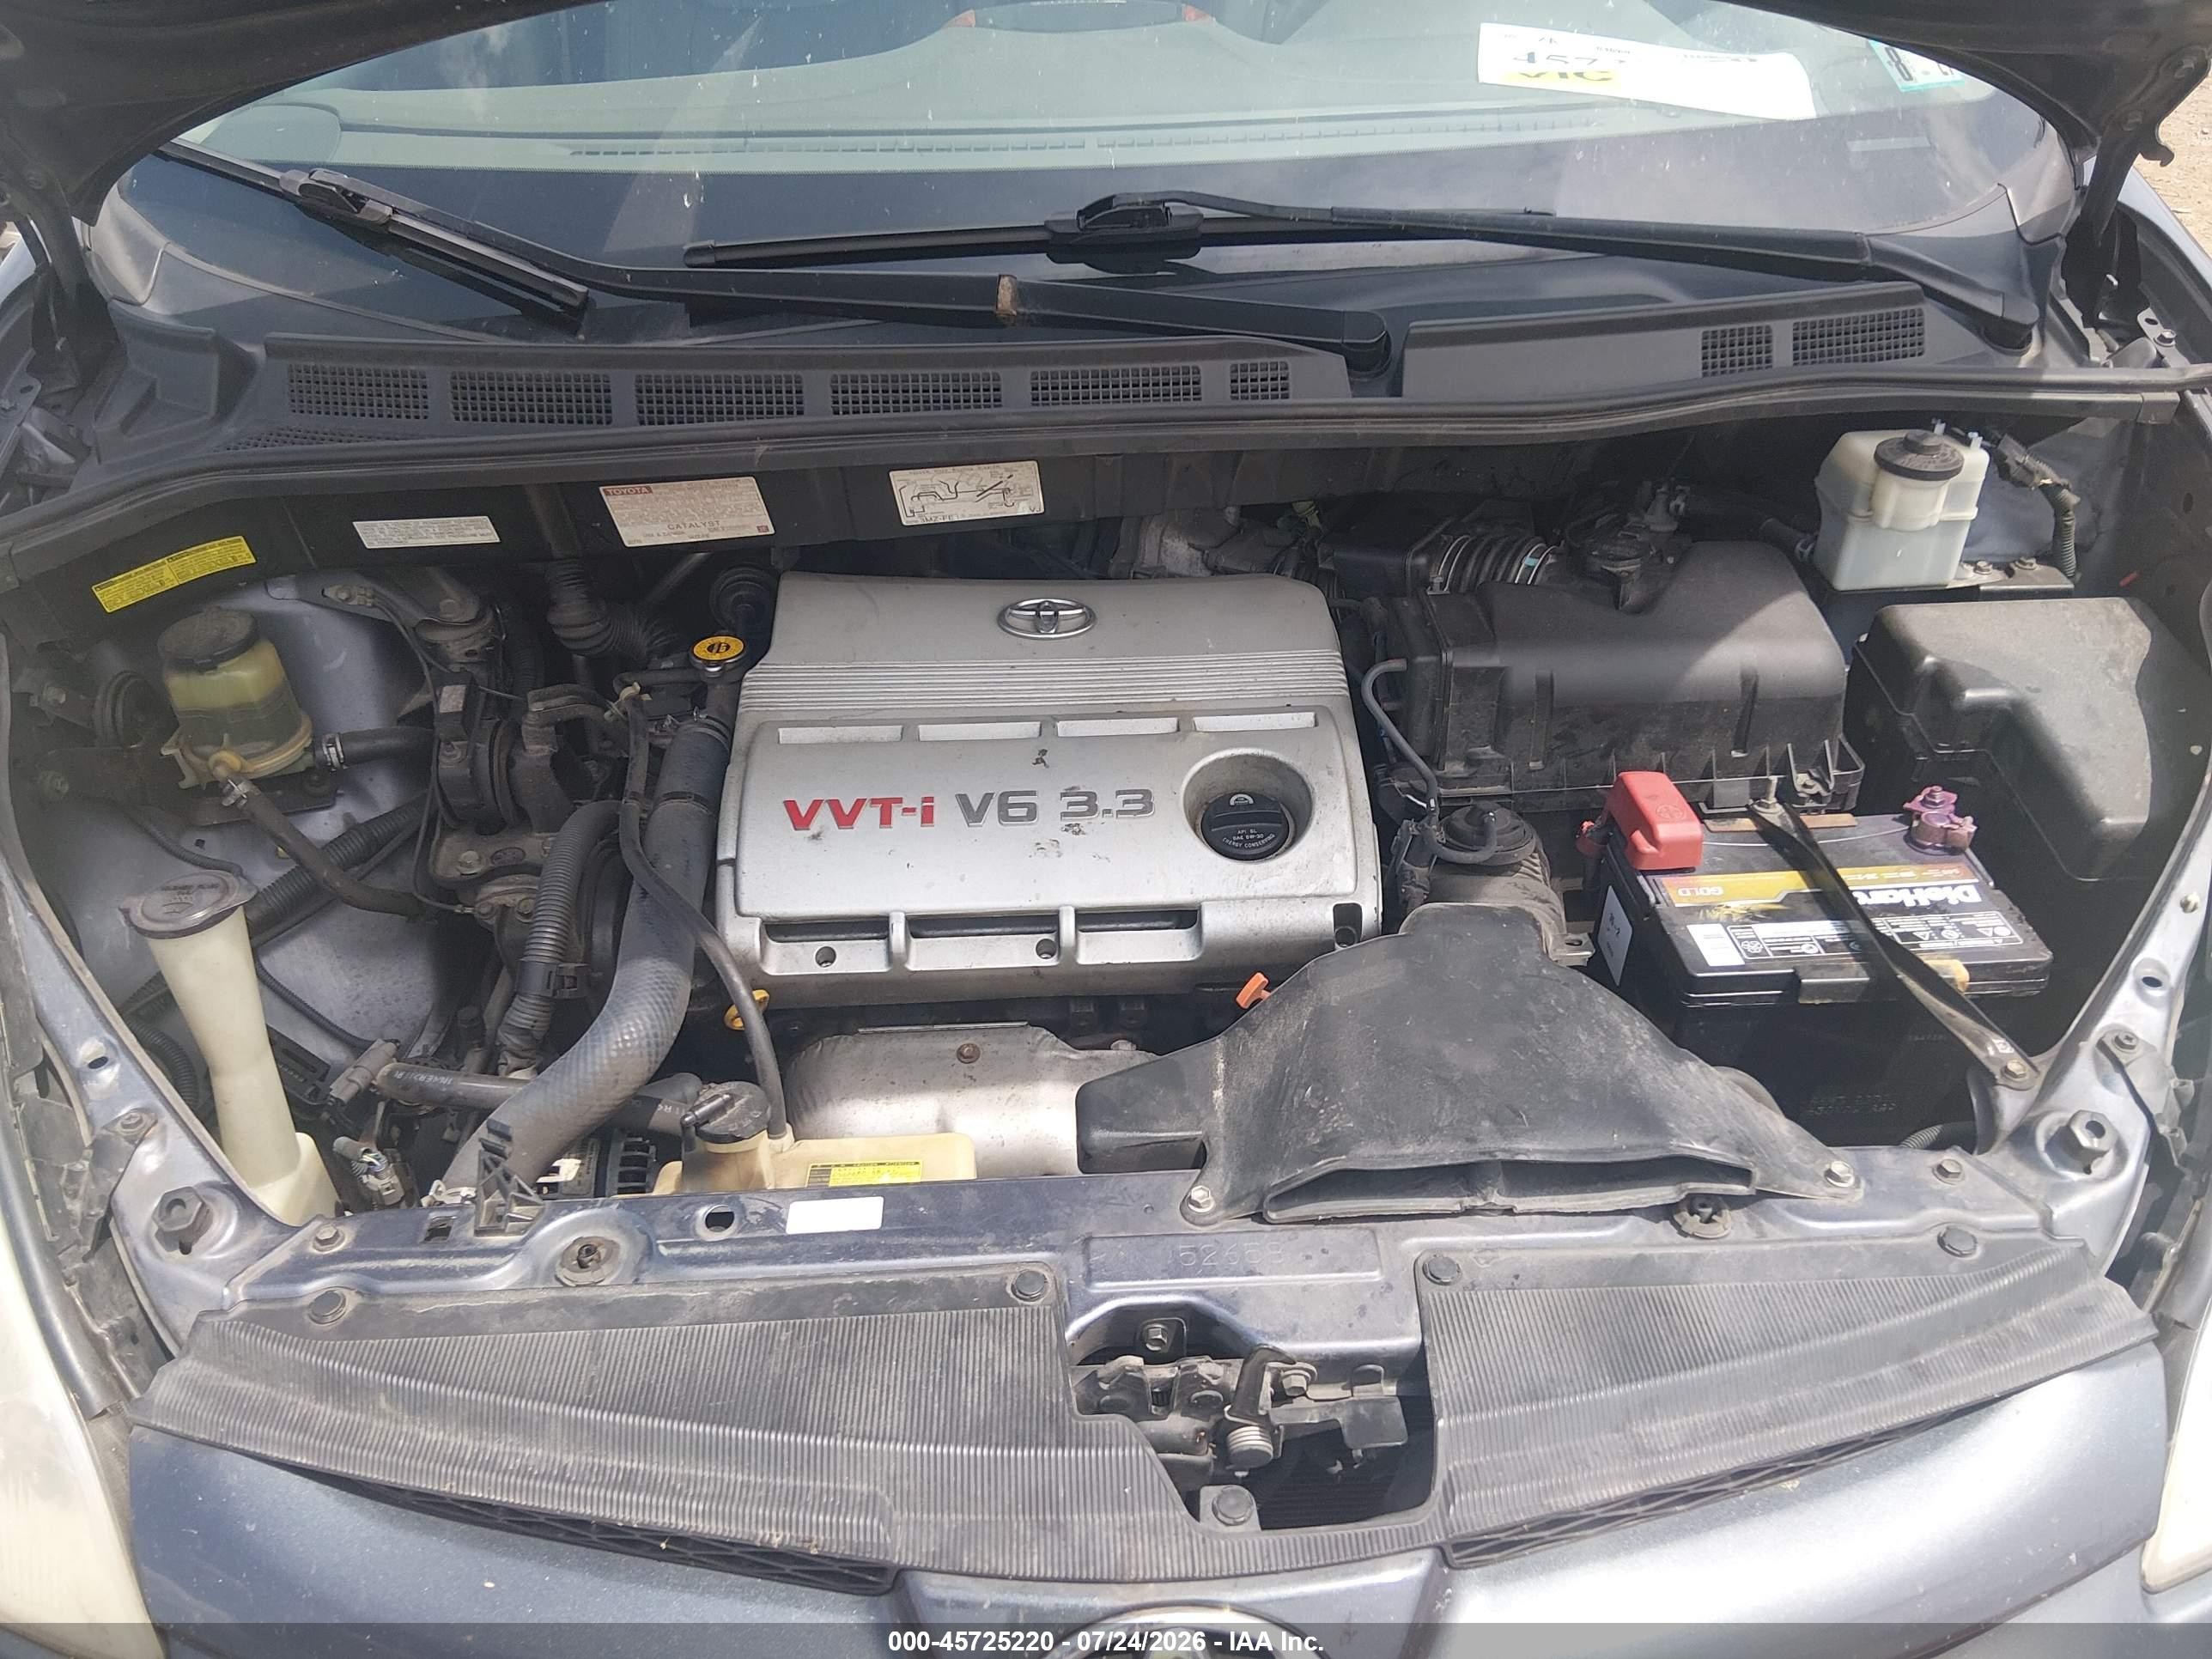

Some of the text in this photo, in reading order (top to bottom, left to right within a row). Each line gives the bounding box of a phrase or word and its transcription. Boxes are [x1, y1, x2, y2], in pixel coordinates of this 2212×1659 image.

[606, 487, 649, 495] TOYOTA
[667, 520, 720, 530] CATALYST
[783, 788, 1153, 830] VVT-i V6 3.3
[1677, 886, 1724, 896] GOLD
